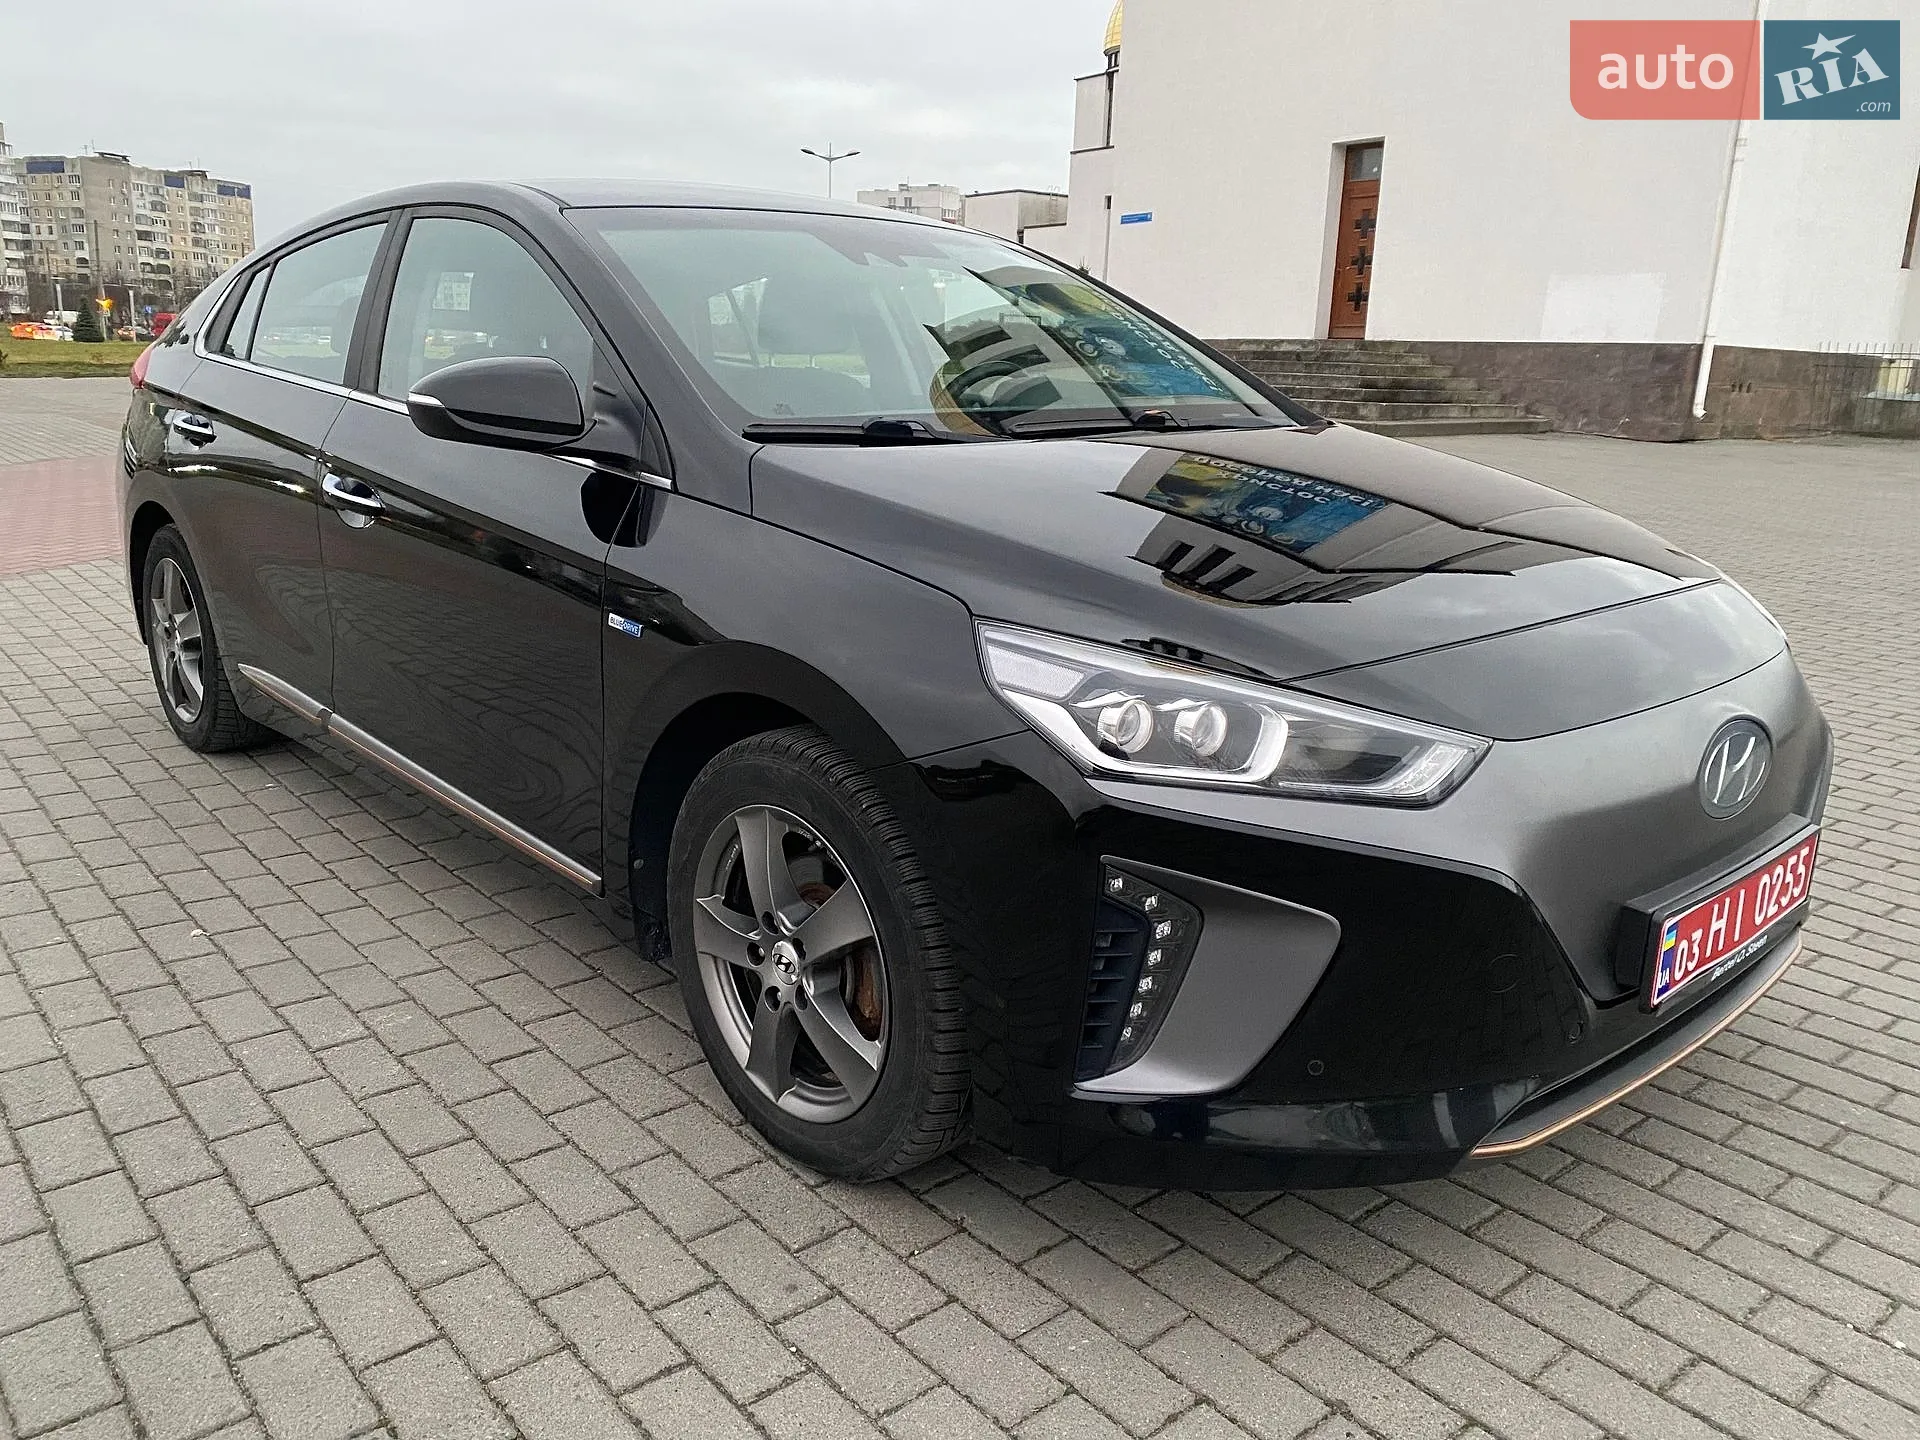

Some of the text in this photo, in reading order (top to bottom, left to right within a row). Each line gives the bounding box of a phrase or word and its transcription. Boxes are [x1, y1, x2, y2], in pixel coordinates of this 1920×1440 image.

[1674, 846, 1810, 981] 03 HI 0255
[1658, 970, 1670, 989] UA
